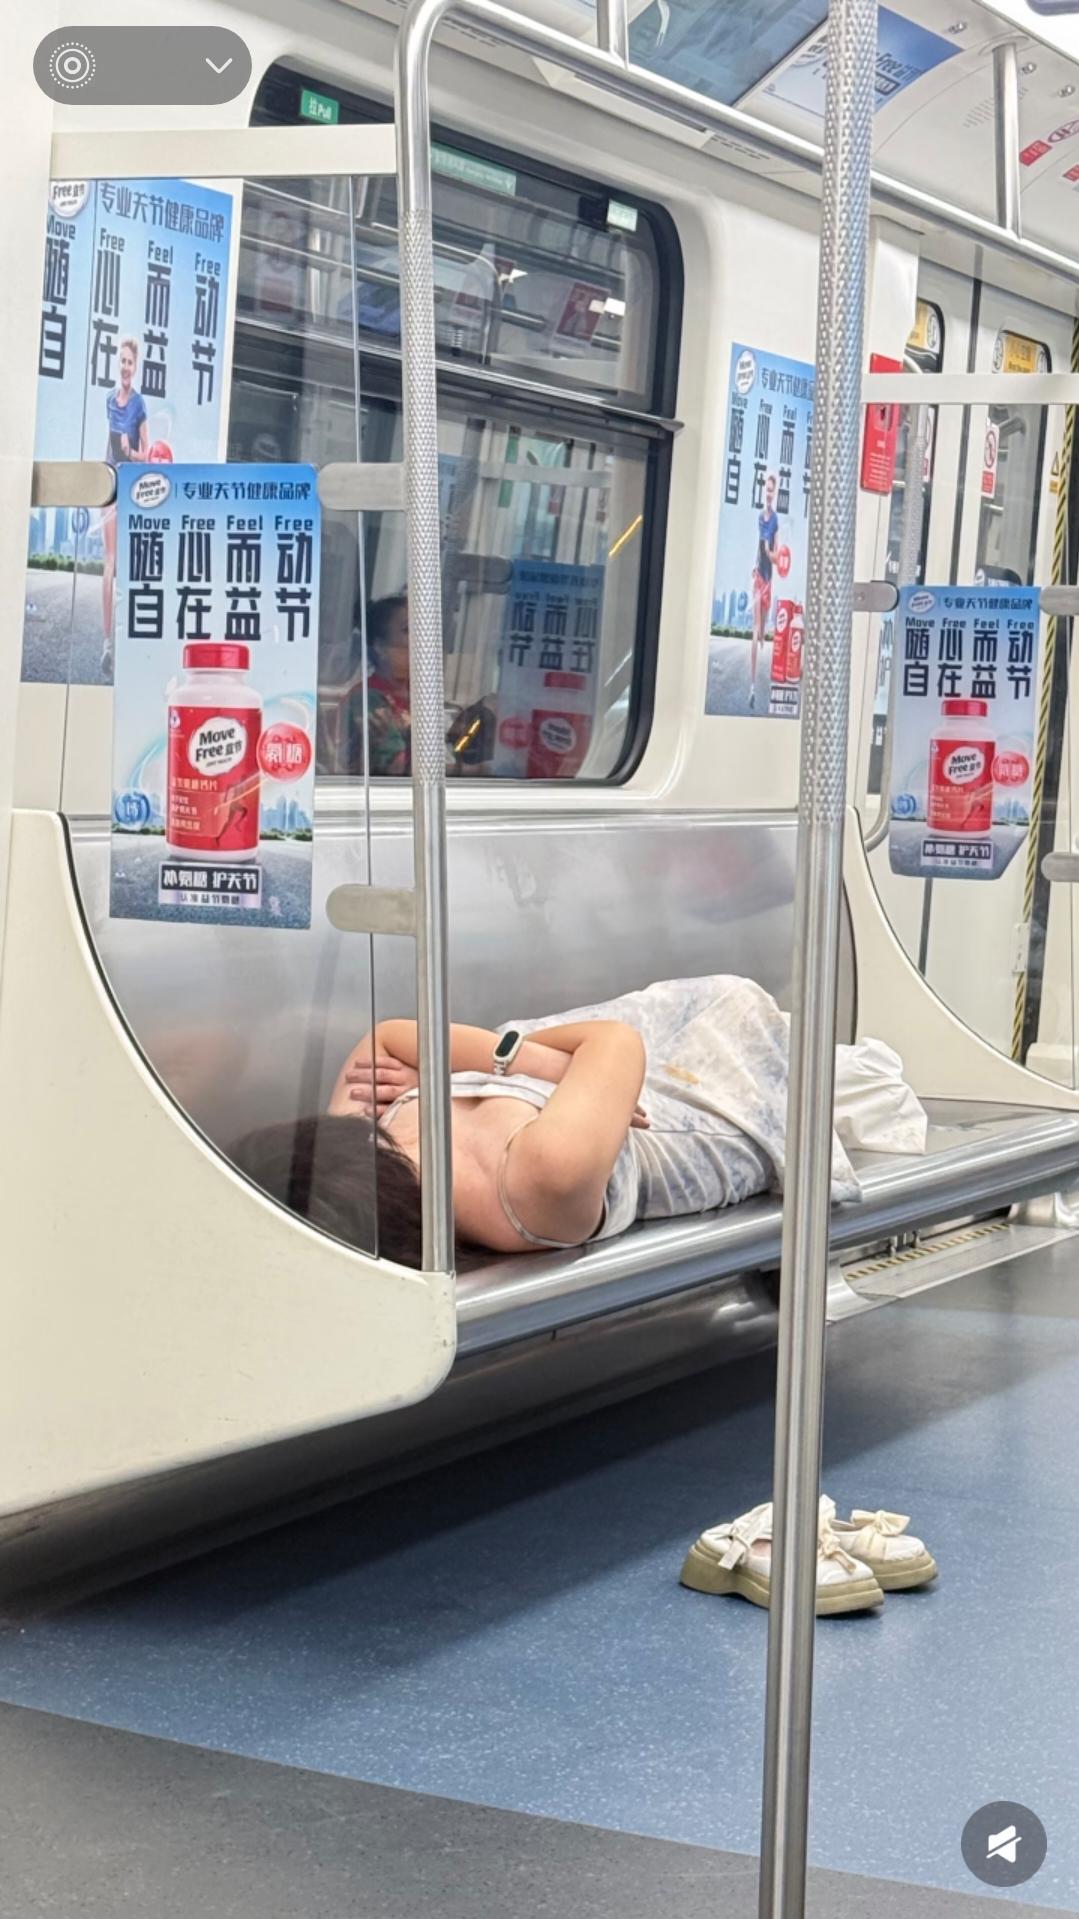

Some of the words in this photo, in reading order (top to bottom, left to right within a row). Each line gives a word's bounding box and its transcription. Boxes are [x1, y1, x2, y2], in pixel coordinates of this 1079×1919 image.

[53, 184, 73, 200] Free
[99, 182, 225, 244] 专业关节健康品牌
[99, 227, 126, 252] Free
[147, 239, 174, 265] Feel
[194, 252, 222, 277] Free
[38, 305, 217, 406] 自在益节
[183, 482, 312, 500] 专业关节健康品牌
[128, 514, 171, 530] Move
[181, 514, 216, 530] Free
[227, 514, 263, 531] Feel
[275, 515, 313, 531] Free
[128, 531, 313, 584] 随心而动
[127, 583, 312, 642] 自在益节
[905, 616, 935, 628] Move
[942, 617, 966, 629] Free
[973, 618, 1000, 629] Feel
[1007, 619, 1034, 630] Free
[904, 628, 1033, 663] 随心而动
[902, 661, 1032, 699] 自在益节
[199, 728, 236, 746] Move
[195, 744, 224, 762] Free
[950, 753, 977, 764] Move
[948, 763, 969, 776] Free
